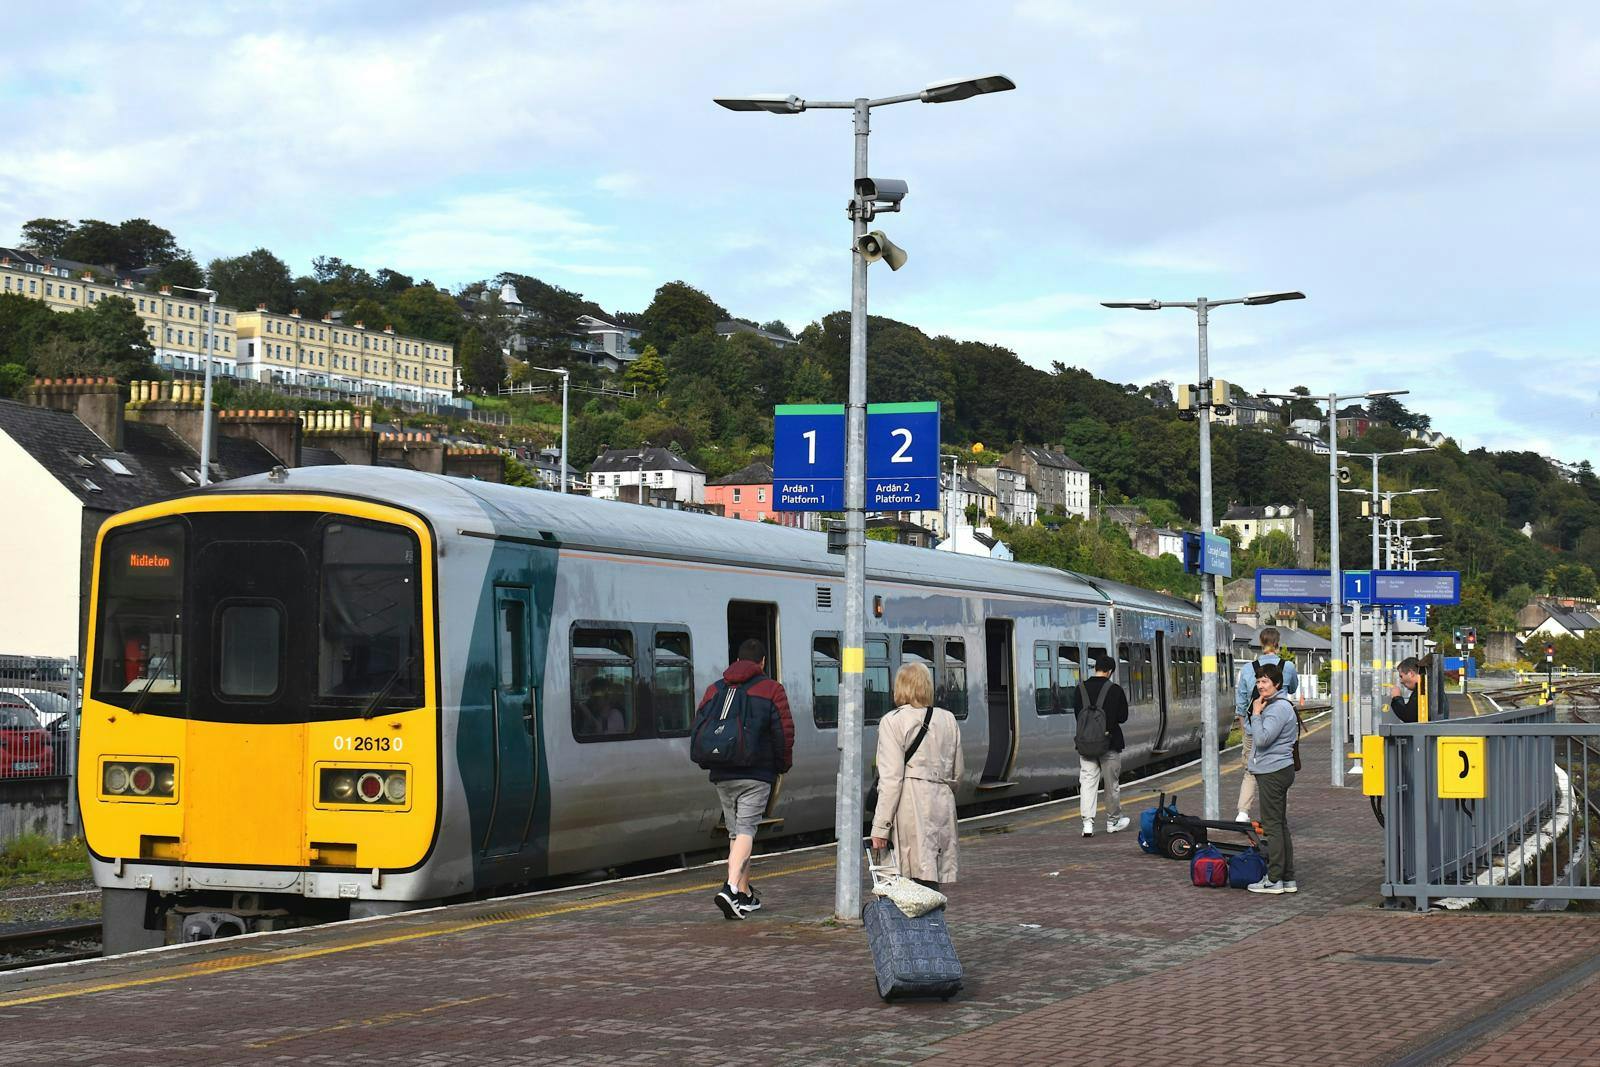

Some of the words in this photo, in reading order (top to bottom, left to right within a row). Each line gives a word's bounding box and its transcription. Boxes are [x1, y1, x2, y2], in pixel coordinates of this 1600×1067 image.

[803, 429, 816, 464] 1
[890, 427, 913, 463] 2
[782, 484, 808, 493] Ardán
[810, 484, 815, 493] 1
[876, 483, 902, 492] Ardán
[903, 483, 910, 492] 2
[781, 495, 819, 504] Platform
[821, 495, 825, 503] 1
[875, 494, 913, 503] Platform
[914, 494, 921, 503] 2
[130, 554, 170, 567] Midleton
[1354, 579, 1361, 593] 1
[1413, 606, 1421, 615] 2
